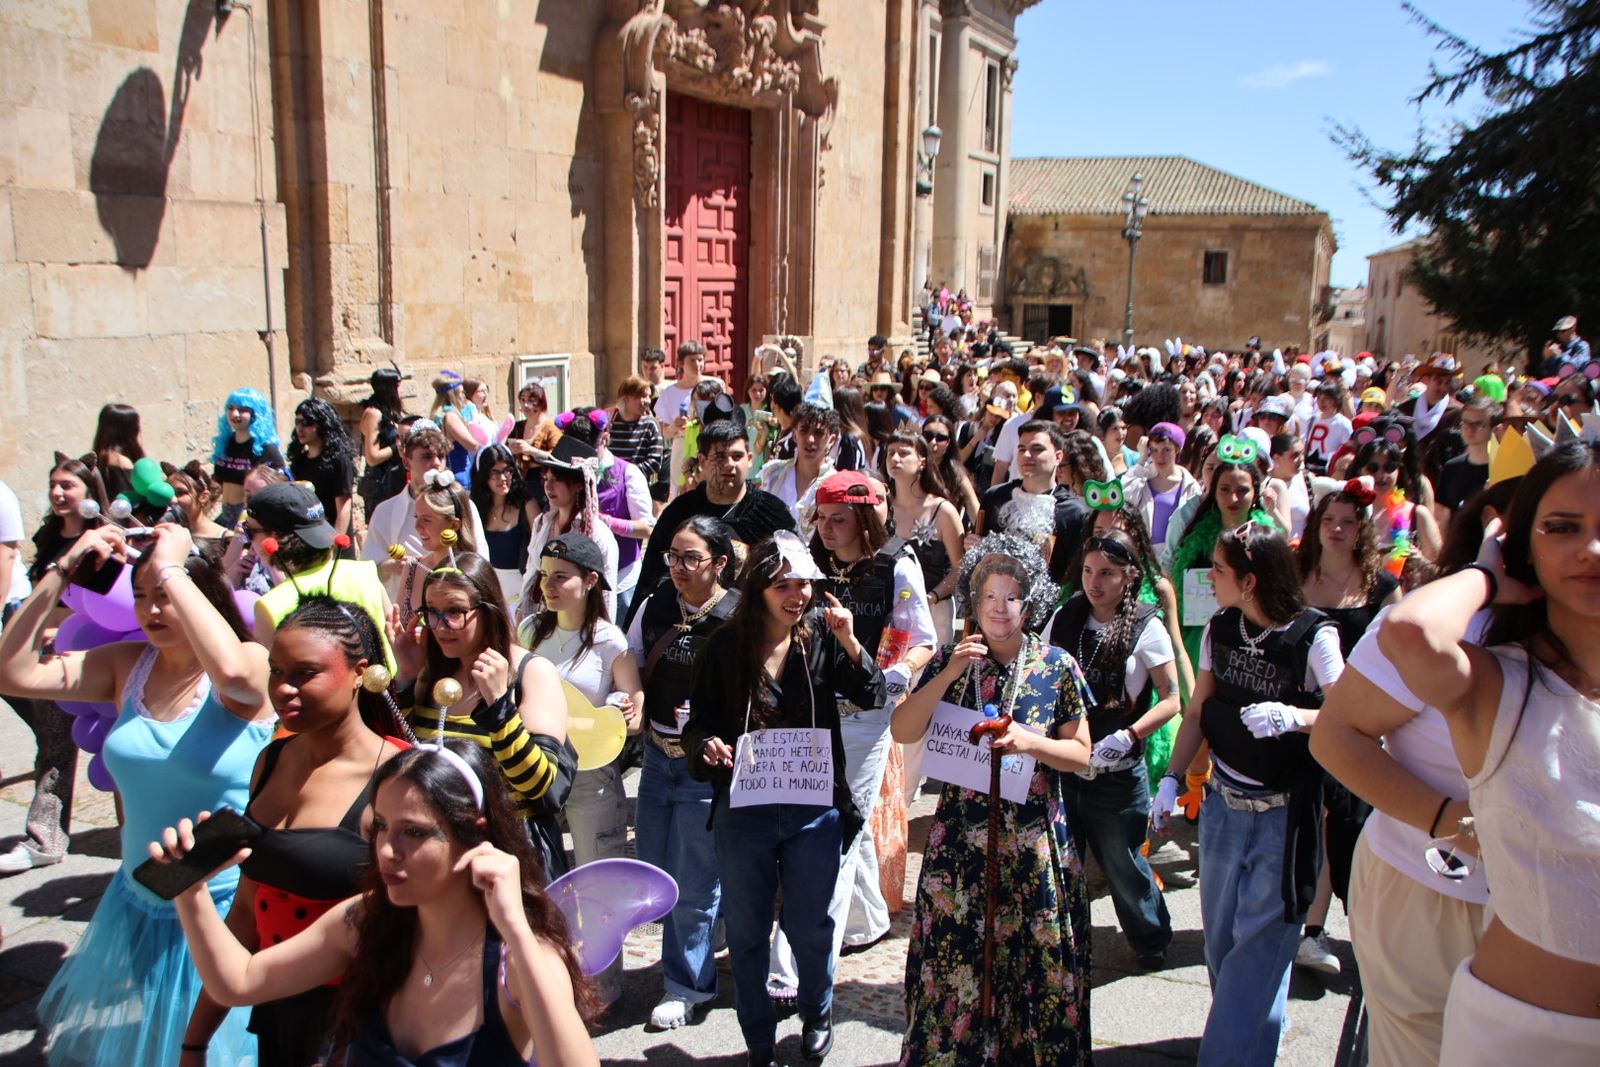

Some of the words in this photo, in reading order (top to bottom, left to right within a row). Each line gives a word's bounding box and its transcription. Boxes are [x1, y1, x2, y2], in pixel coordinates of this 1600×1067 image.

[1307, 423, 1328, 453] R
[833, 585, 853, 600] LA
[673, 635, 693, 649] HE
[661, 646, 696, 665] ACHIN
[1229, 650, 1276, 679] BASED
[1222, 666, 1281, 698] ANTUAN
[773, 730, 811, 744] ESTÁIS
[931, 722, 970, 742] ¡VÁYAS
[926, 739, 970, 759] CUESTA!
[782, 761, 794, 773] DE
[800, 760, 829, 774] AQUÍ
[738, 777, 767, 791] TODO
[773, 777, 783, 789] EL
[788, 778, 829, 792] MUNDO!
